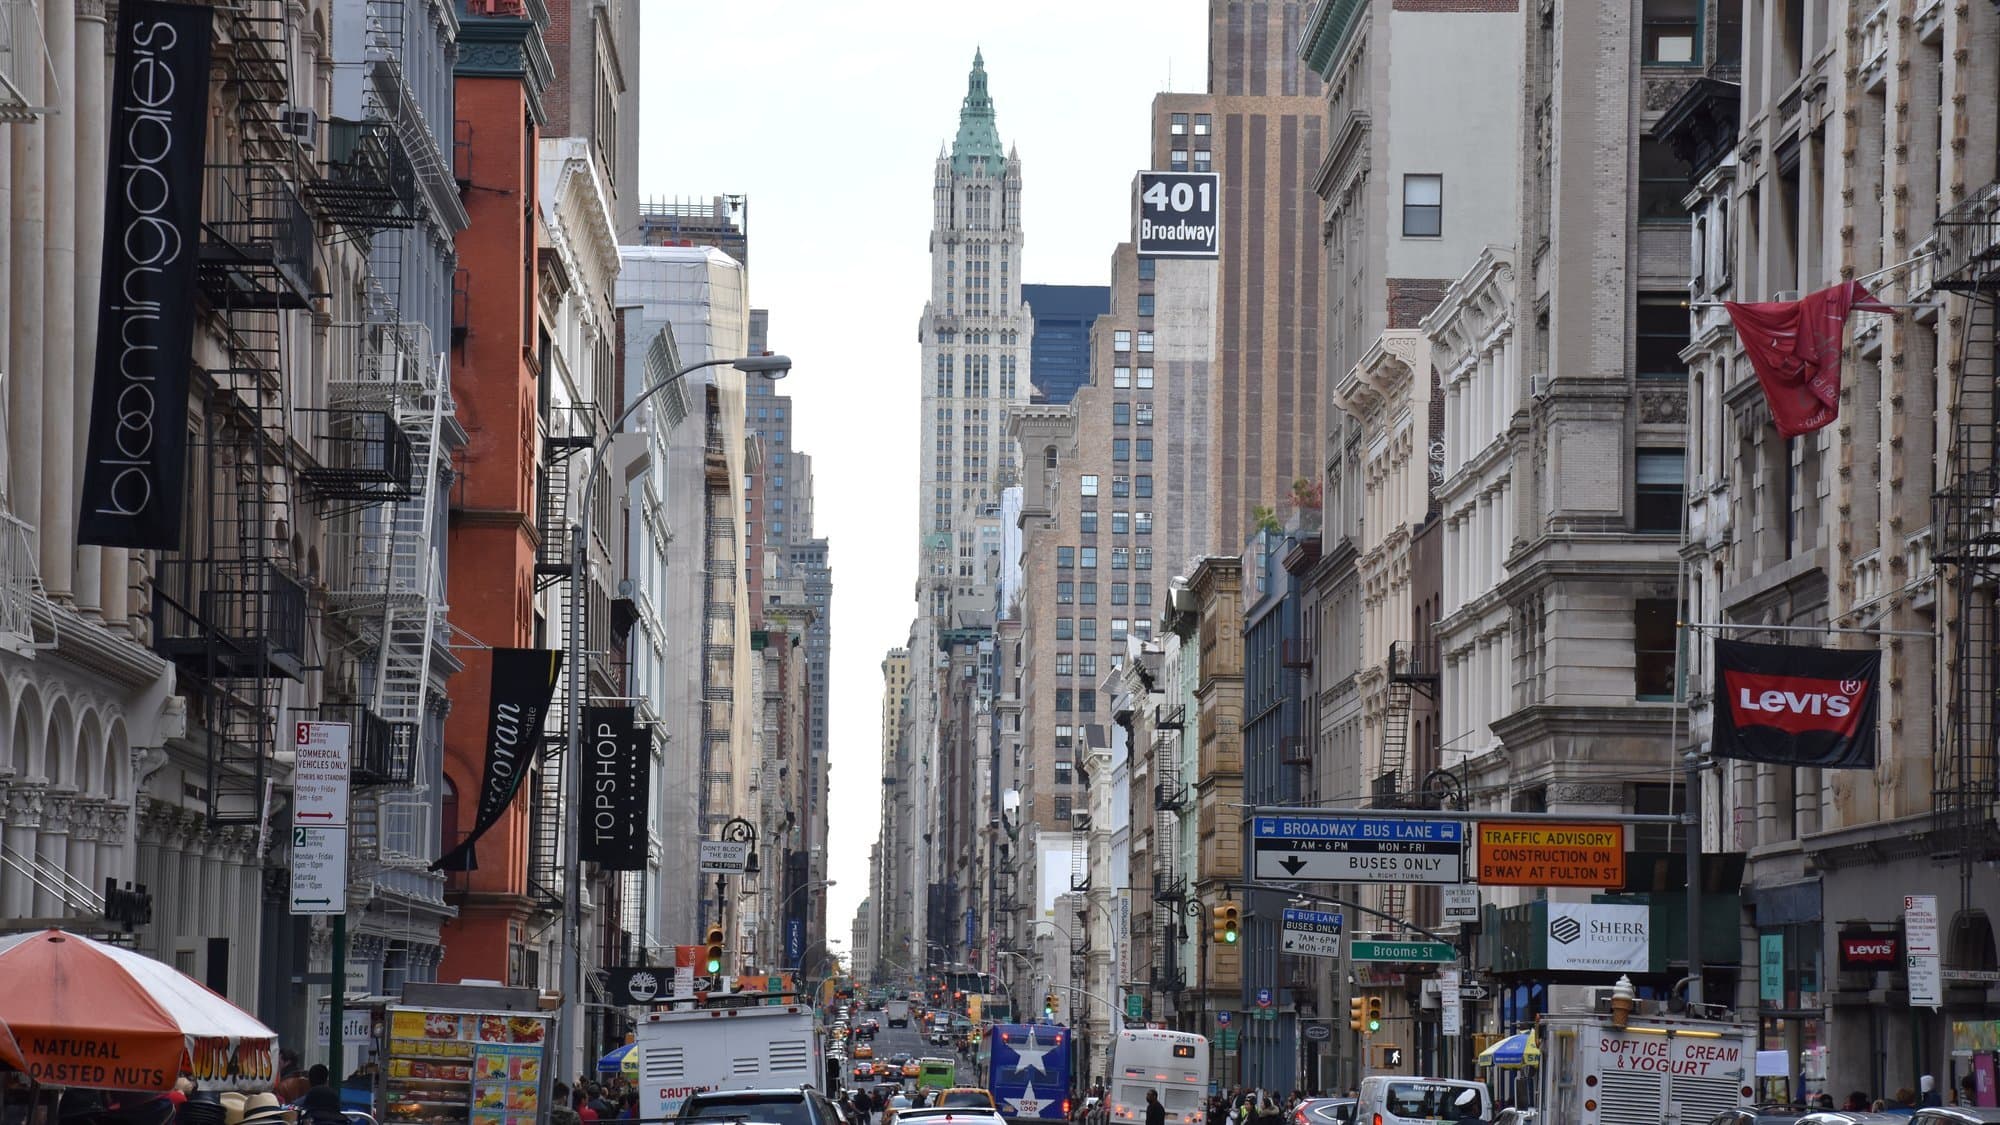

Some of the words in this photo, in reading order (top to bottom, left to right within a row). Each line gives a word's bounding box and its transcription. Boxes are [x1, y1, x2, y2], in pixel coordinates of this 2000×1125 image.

[1142, 182, 1210, 212] 401
[1141, 218, 1215, 247] Broadway
[299, 725, 308, 743] 3
[298, 749, 341, 758] COMMERCIAL
[298, 760, 329, 769] VEHICLES
[331, 761, 347, 770] ONLY
[297, 784, 316, 792] Monday
[321, 785, 336, 793] Friday
[596, 723, 617, 846] TOPSHOP
[296, 828, 304, 846] 2
[1284, 822, 1357, 836] BROADWAY
[1364, 824, 1389, 837] BUS
[1396, 826, 1432, 838] LANE
[1486, 832, 1540, 844] TRAFFIC
[1547, 833, 1613, 845] ADVISORY
[1378, 843, 1399, 851] MON
[1410, 844, 1426, 852] FRI
[1350, 856, 1397, 870] BUSES
[1404, 858, 1441, 871] ONLY
[1493, 850, 1587, 863] CONSTRUCTION
[1593, 851, 1610, 863] ON
[1484, 866, 1522, 878] B'WAY
[1529, 867, 1544, 878] AT
[1550, 867, 1598, 879] FULTON
[1603, 868, 1618, 879] ST
[1906, 898, 1911, 909] 3
[1318, 914, 1340, 923] LANE
[1286, 921, 1314, 930] BUSES
[1316, 924, 1338, 933] ONLY
[1590, 920, 1644, 934] SHERR
[1374, 946, 1417, 957] Broome
[1422, 947, 1433, 957] St
[1909, 957, 1915, 966] 2
[344, 1020, 368, 1035] offee
[33, 1039, 120, 1059] NATURAL
[1600, 1039, 1637, 1054] SOFT
[1643, 1042, 1668, 1056] ICE
[1685, 1045, 1739, 1062] CREAM
[192, 1036, 230, 1080] NUTS
[239, 1037, 272, 1082] NUTS
[1617, 1055, 1625, 1069] &
[1629, 1056, 1710, 1076] YOGURT
[30, 1062, 104, 1082] OASTED
[114, 1068, 163, 1086] NUTS
